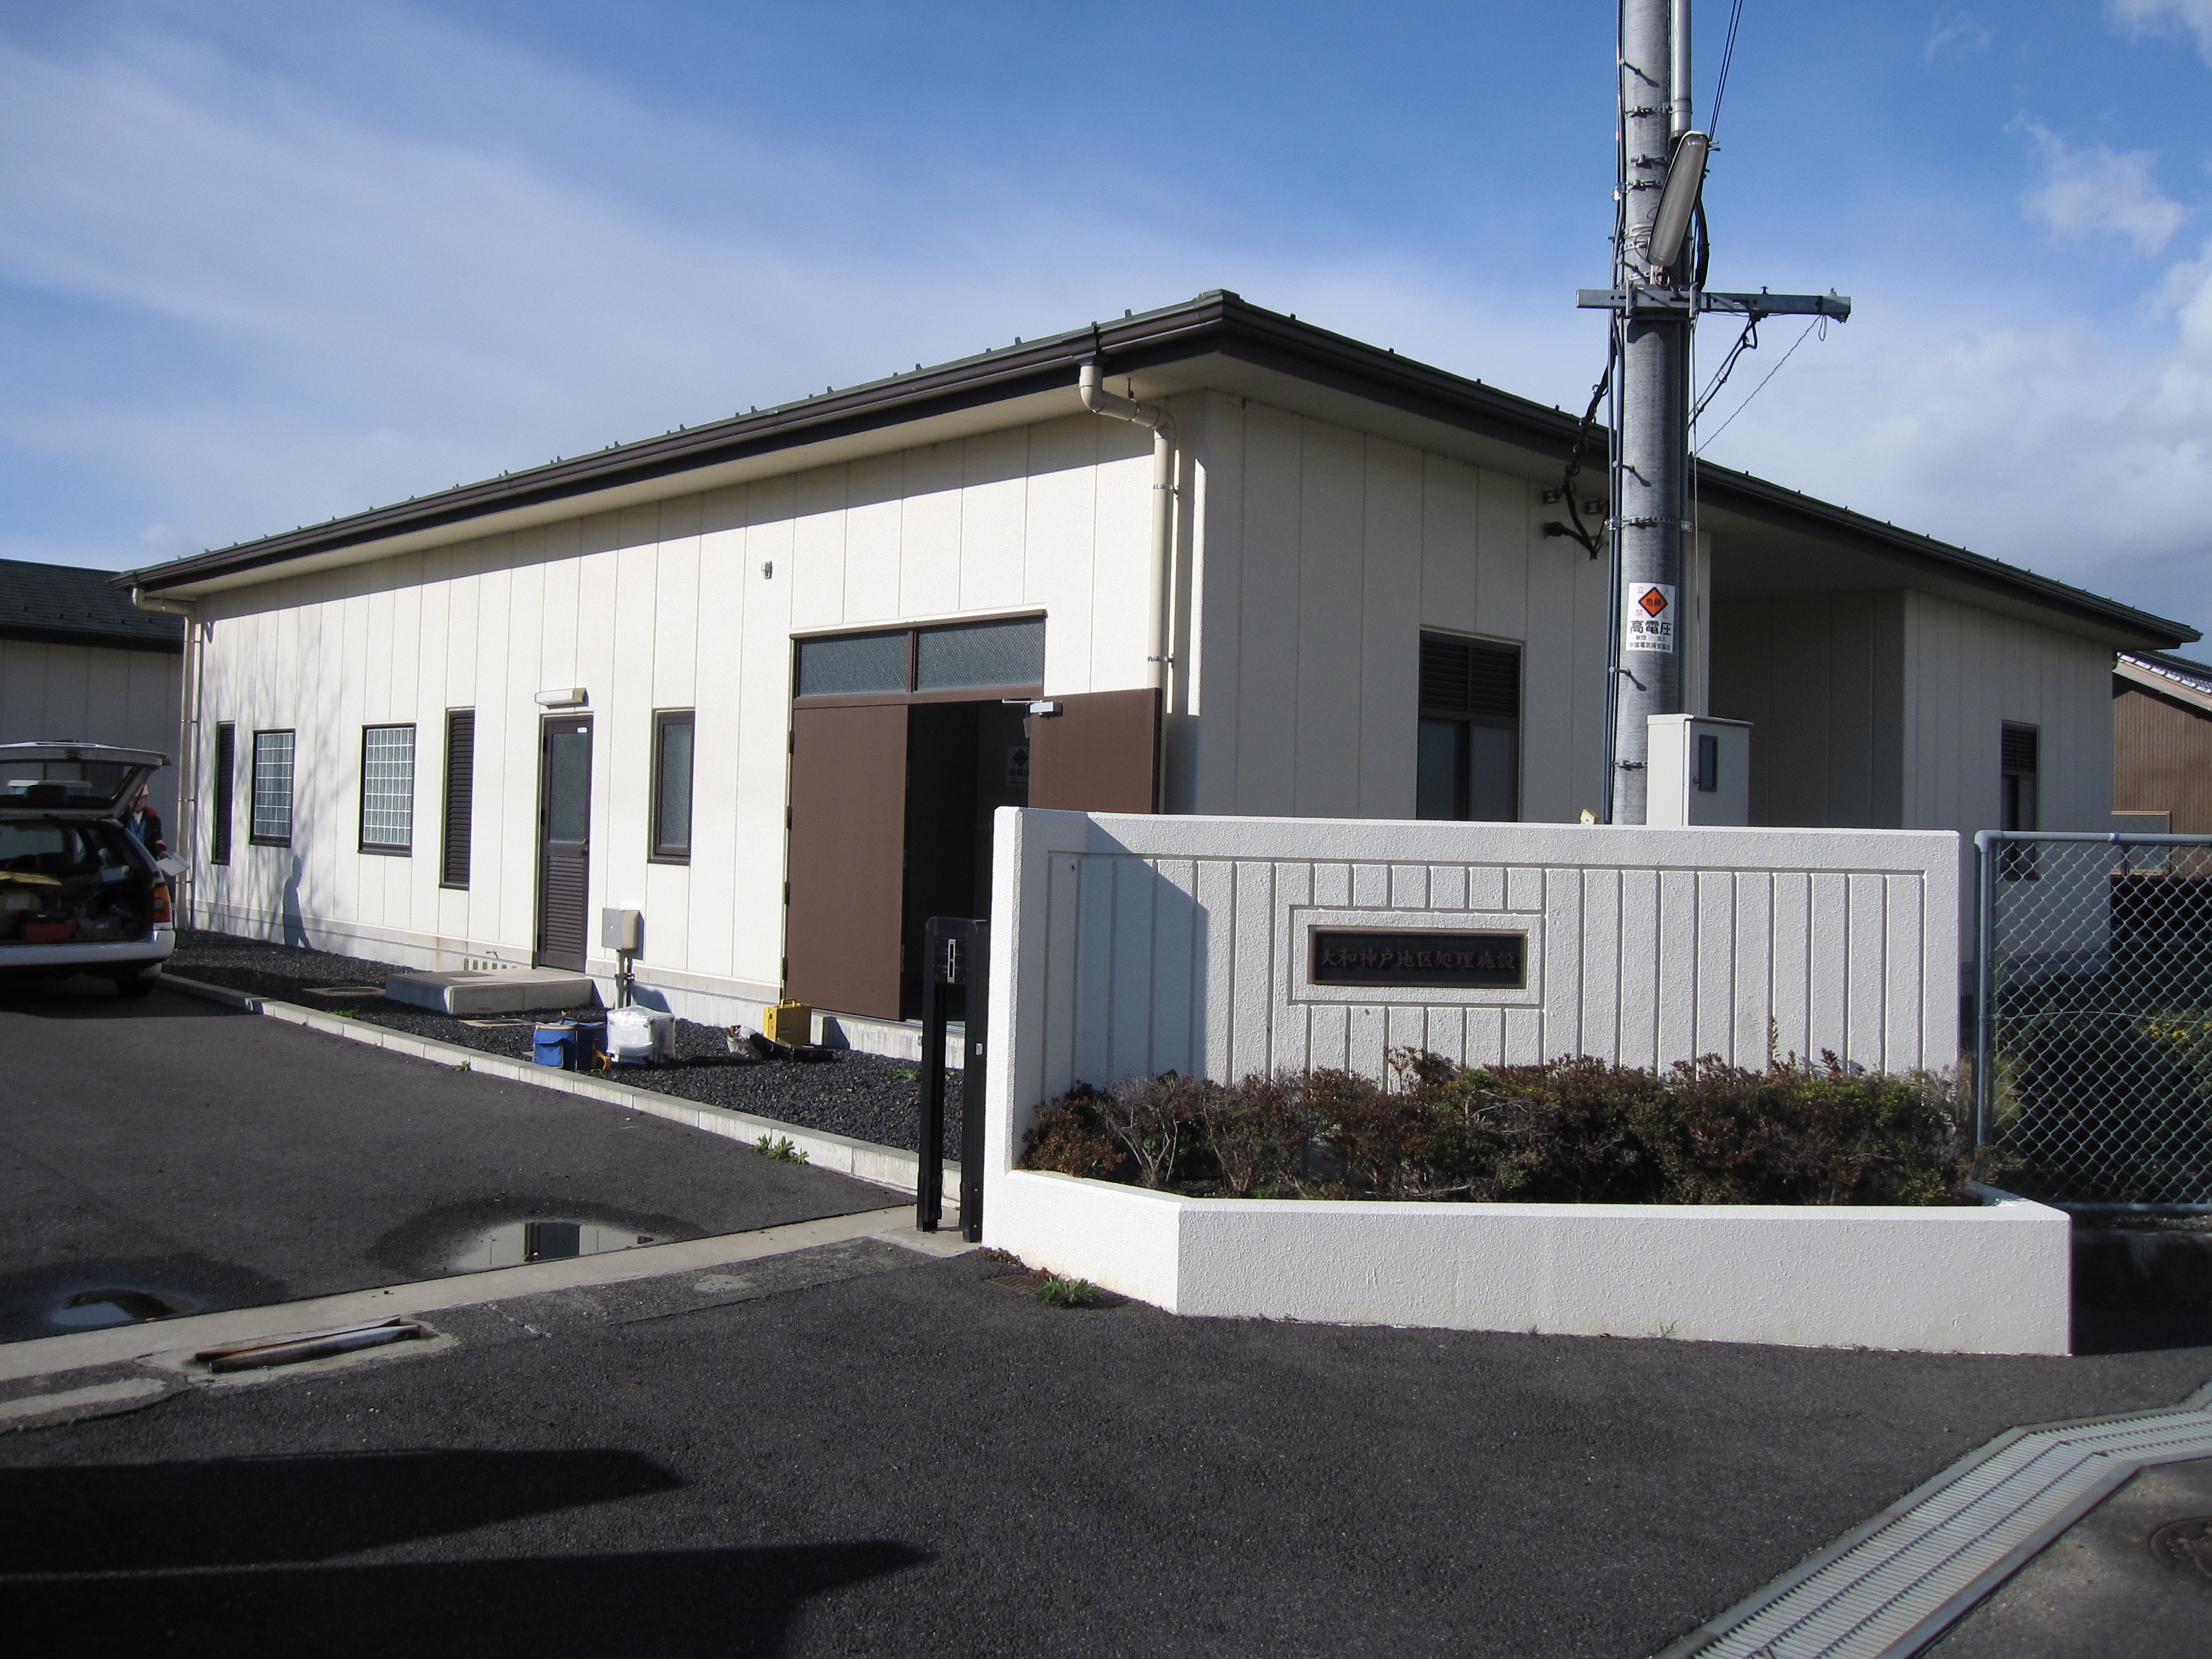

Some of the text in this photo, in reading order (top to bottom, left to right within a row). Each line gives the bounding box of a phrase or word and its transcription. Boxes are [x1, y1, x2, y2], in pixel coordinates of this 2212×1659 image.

[1630, 620, 1672, 635] 高電圧
[1320, 947, 1517, 970] 大和神戸地区処理施設
